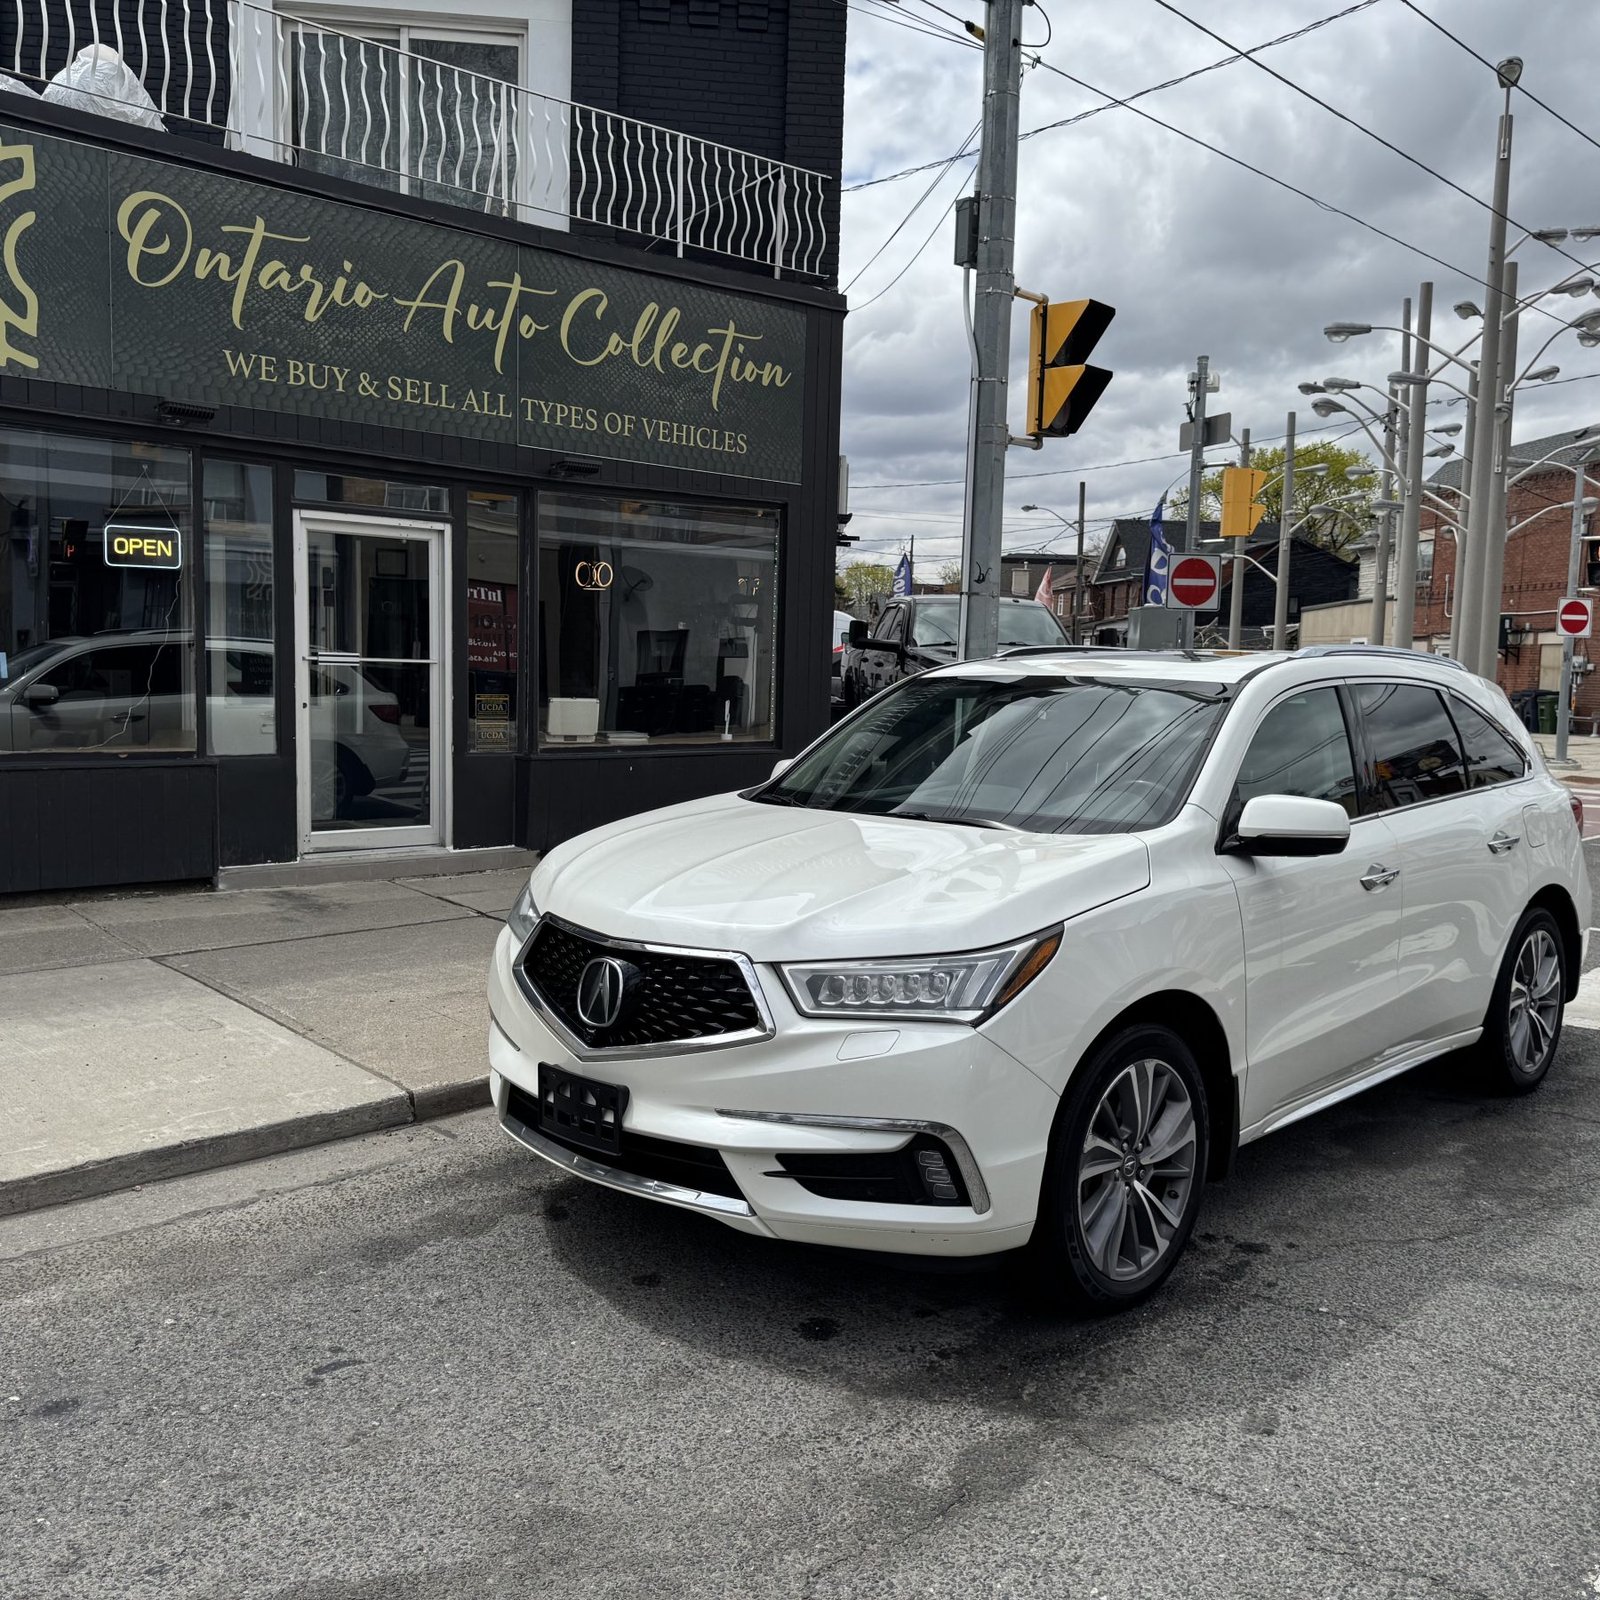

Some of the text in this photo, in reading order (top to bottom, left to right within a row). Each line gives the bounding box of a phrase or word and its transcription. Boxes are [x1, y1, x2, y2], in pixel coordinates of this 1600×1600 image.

[117, 190, 792, 411] Ontario Auto Collection
[222, 349, 748, 455] WE BUY & SELL ALL TYPES OF VEHICLES
[113, 537, 173, 557] OPEN
[481, 703, 504, 711] UCDA
[481, 731, 504, 739] UCDA
